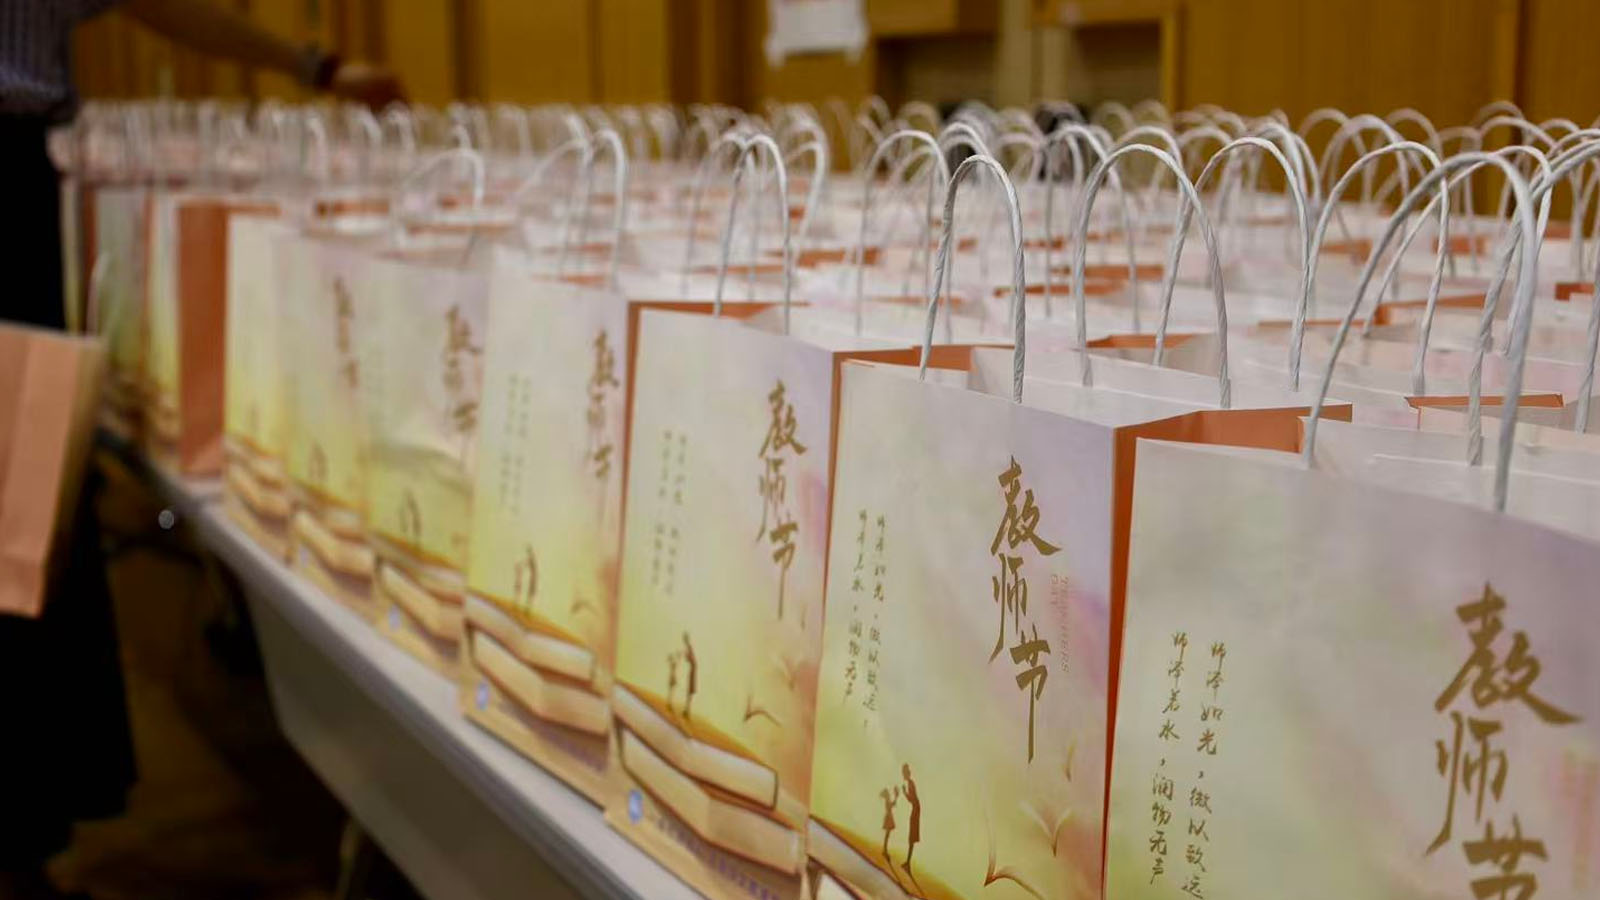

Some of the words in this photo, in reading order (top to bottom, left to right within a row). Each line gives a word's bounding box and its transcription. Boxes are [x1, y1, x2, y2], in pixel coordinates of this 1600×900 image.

[756, 379, 807, 621] 教师节
[987, 455, 1062, 764] 教师节
